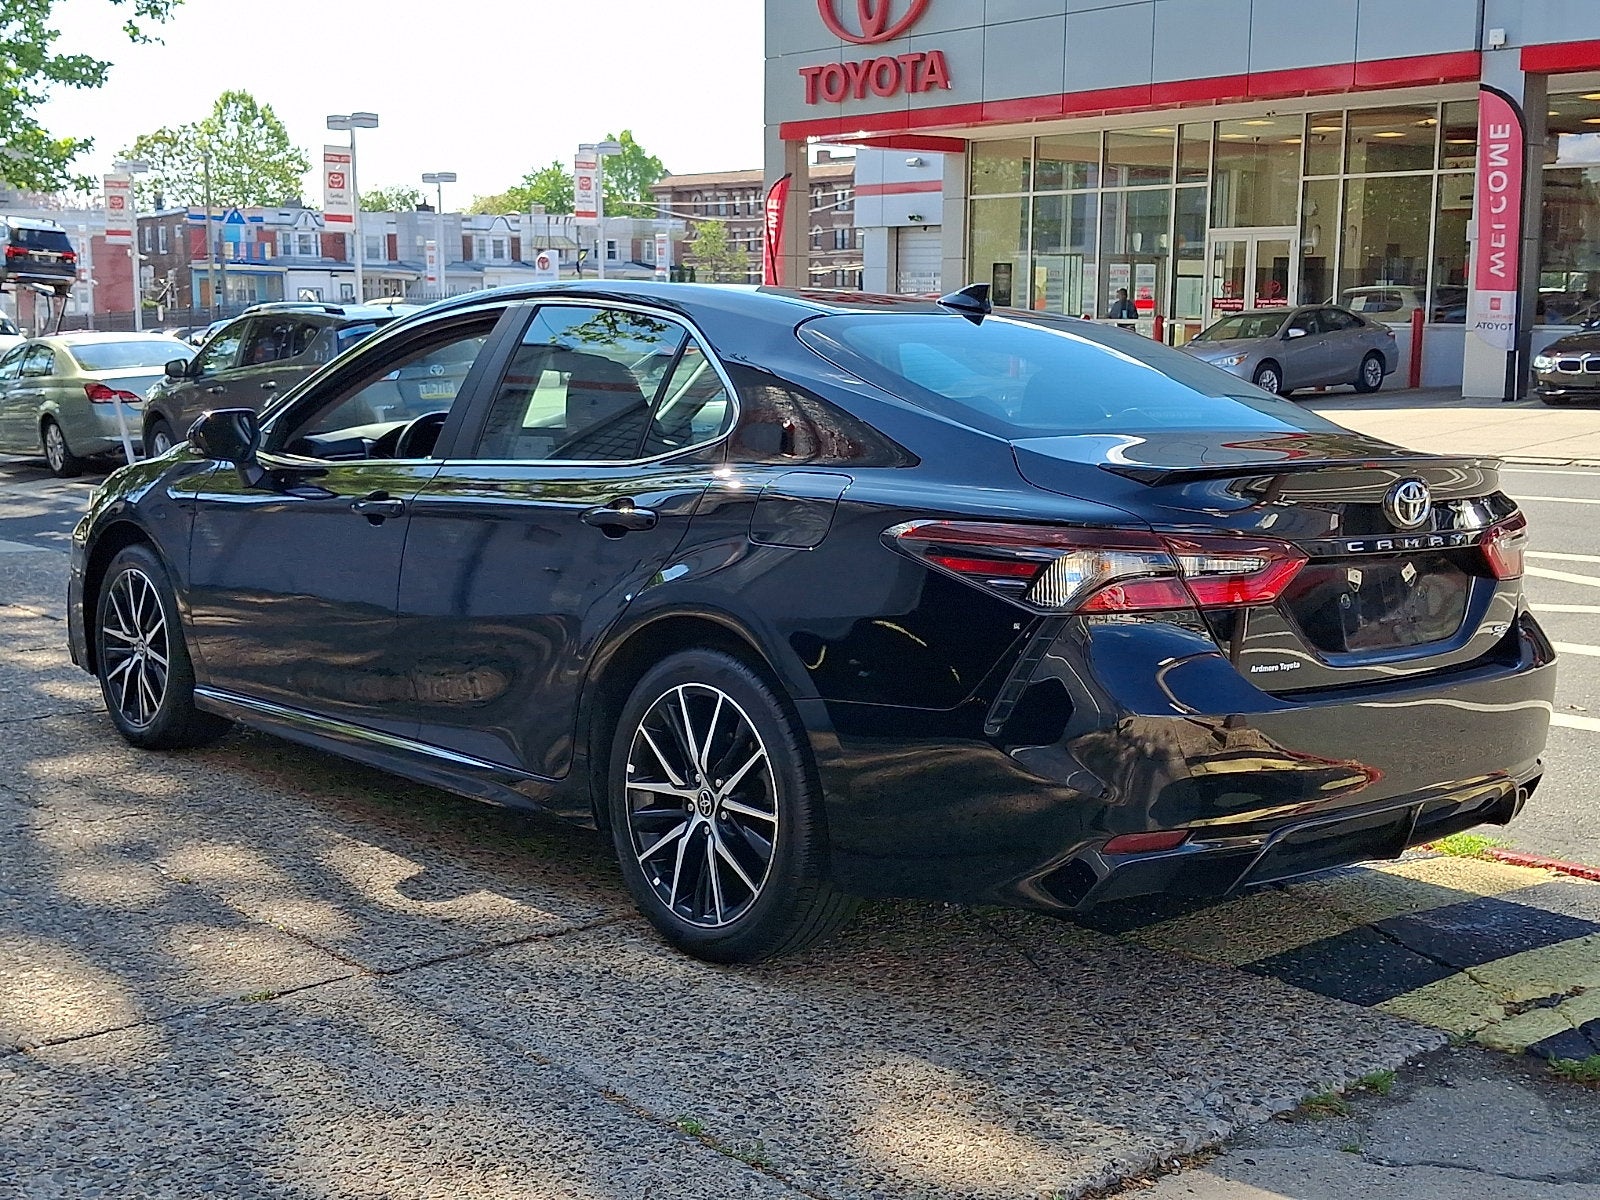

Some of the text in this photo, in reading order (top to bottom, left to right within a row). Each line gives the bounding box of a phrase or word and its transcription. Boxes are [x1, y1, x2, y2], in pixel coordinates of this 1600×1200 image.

[798, 50, 951, 105] TOYOTA
[1347, 533, 1464, 552] CAMRY
[1251, 661, 1301, 673] Ardmore Toyota
